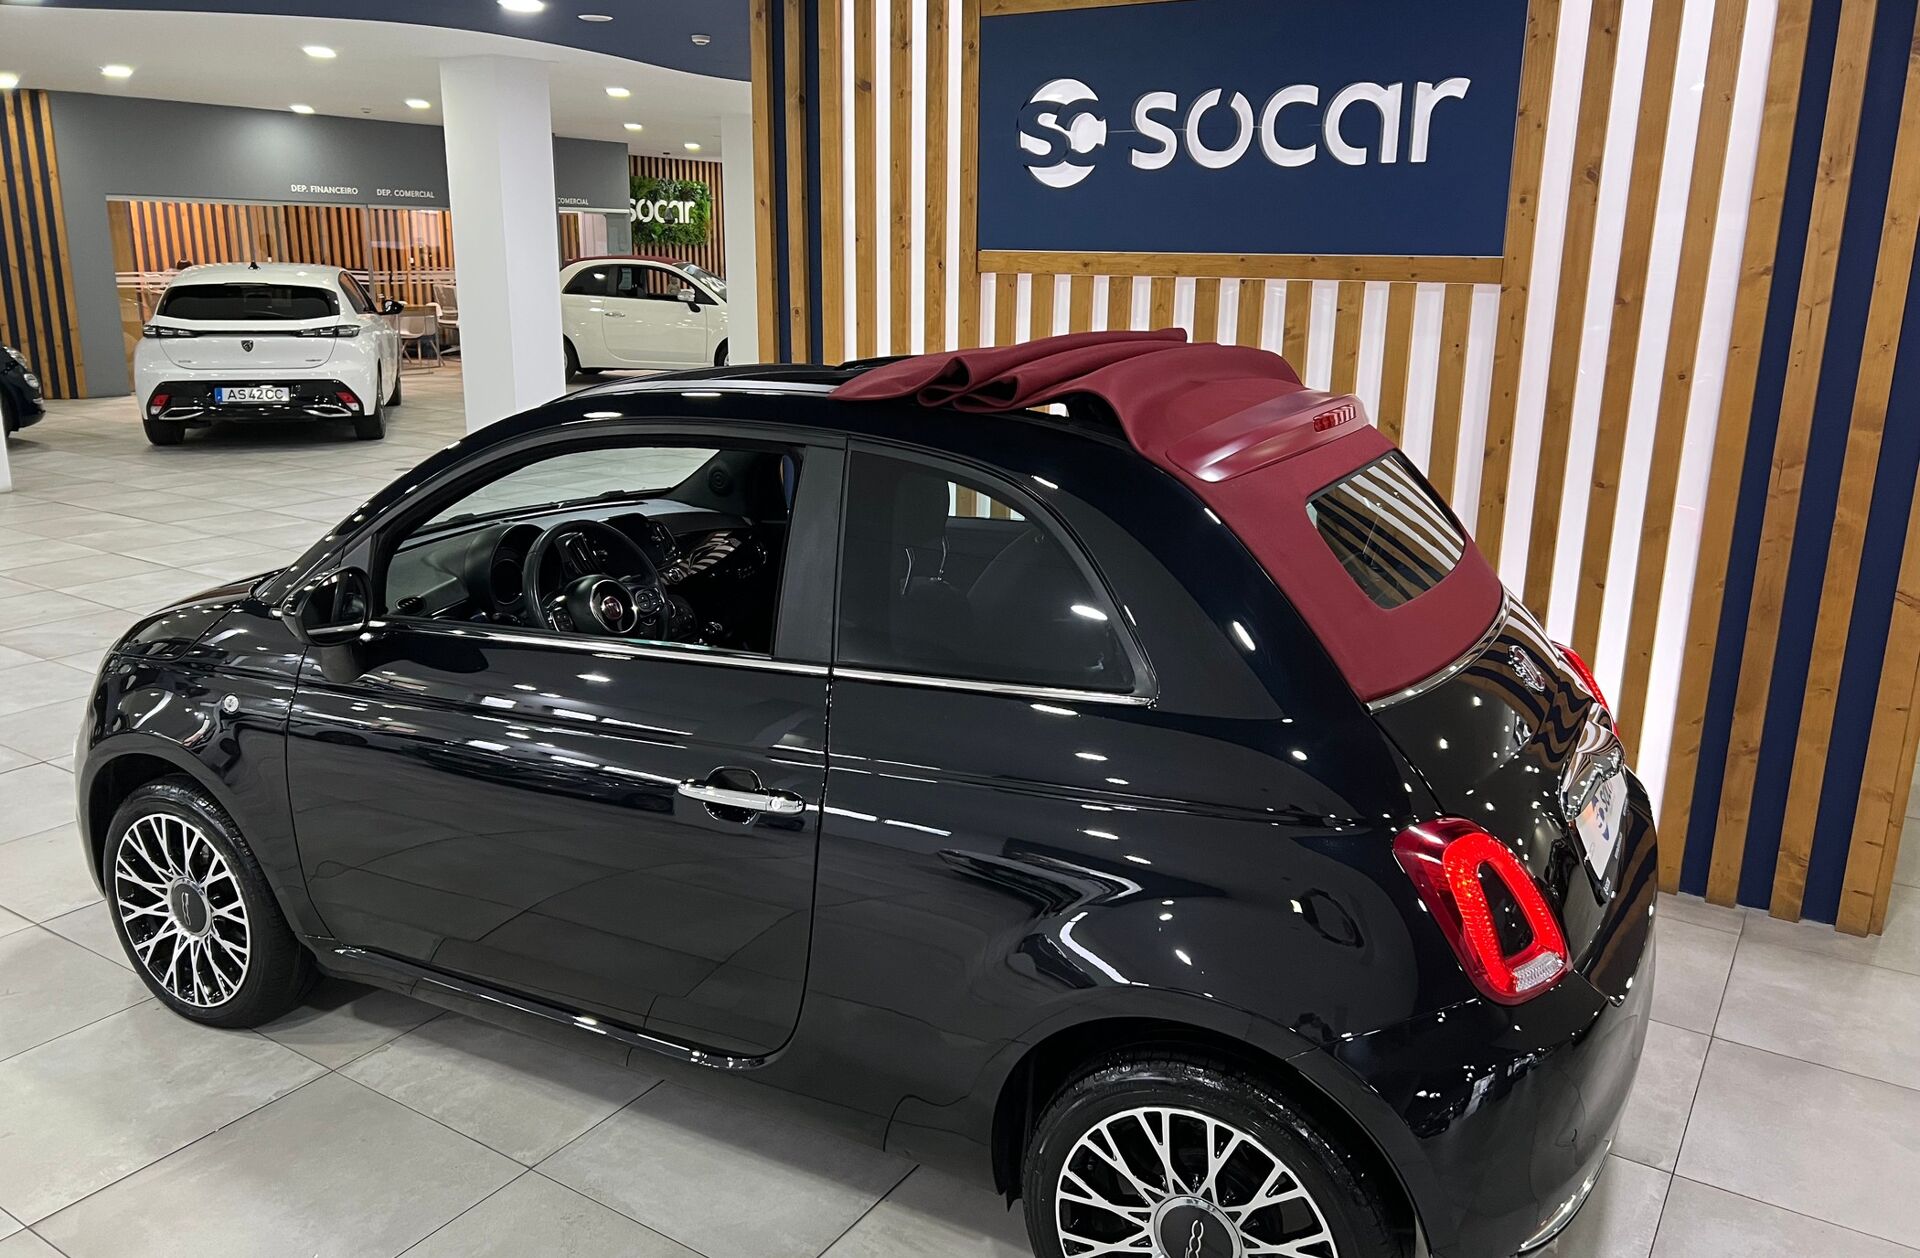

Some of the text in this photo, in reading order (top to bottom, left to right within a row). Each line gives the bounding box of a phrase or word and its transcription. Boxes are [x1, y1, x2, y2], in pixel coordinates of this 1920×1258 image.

[1130, 77, 1471, 170] socar
[291, 184, 358, 195] DEP. FINANCEIRO
[376, 188, 435, 198] DEP. COMERCIAL
